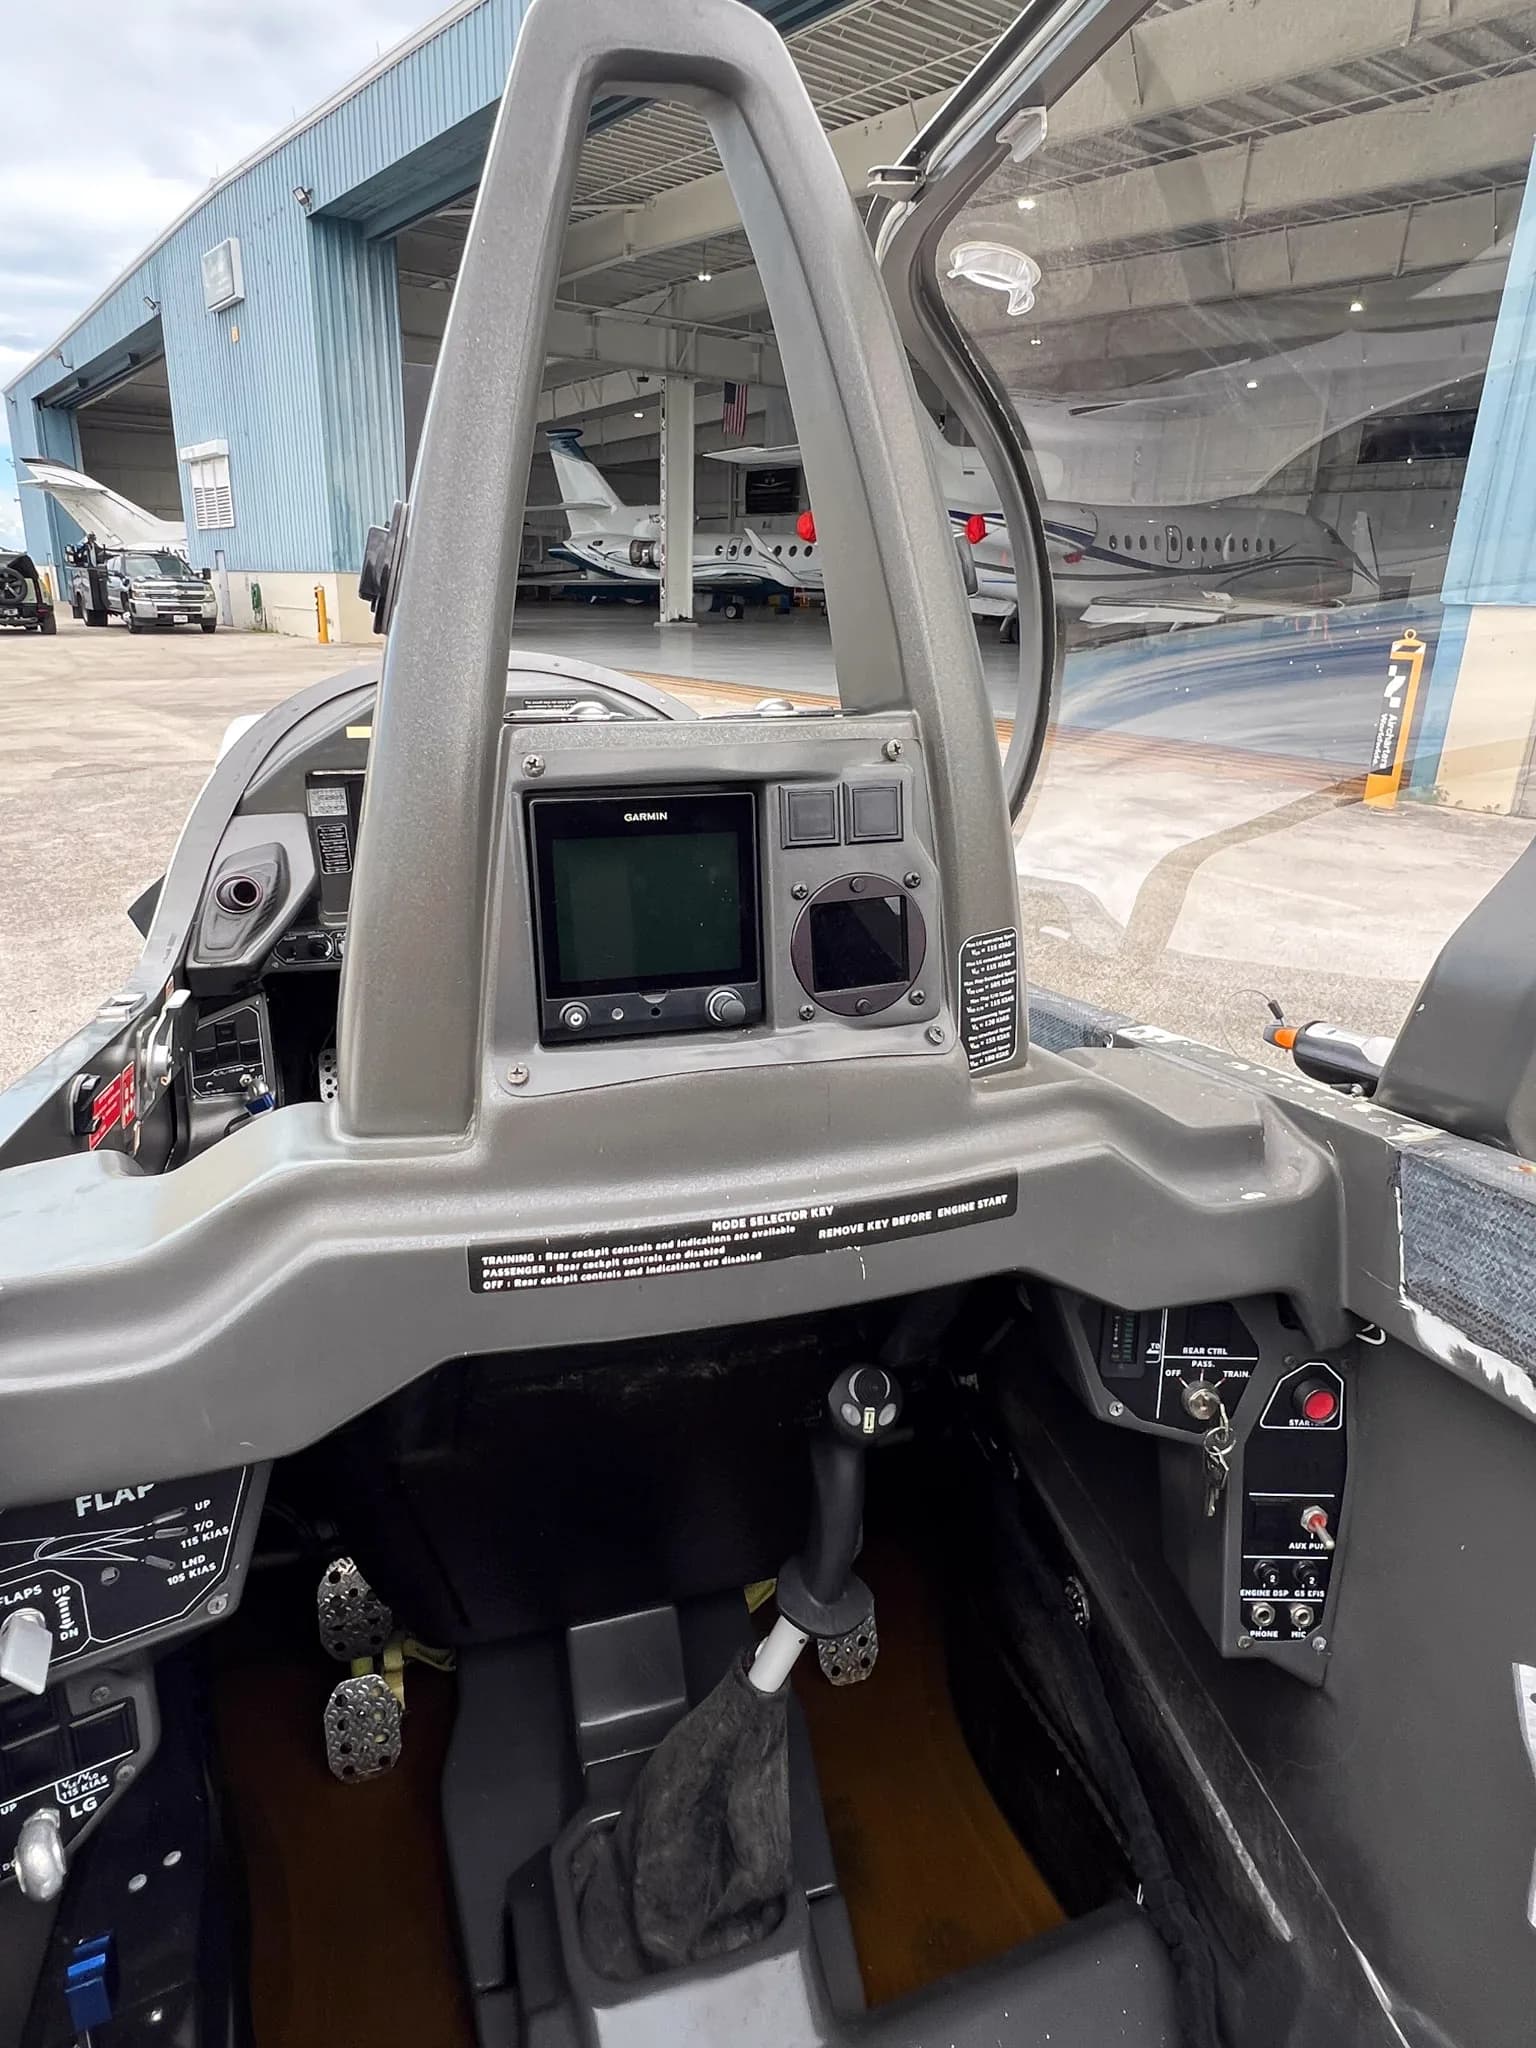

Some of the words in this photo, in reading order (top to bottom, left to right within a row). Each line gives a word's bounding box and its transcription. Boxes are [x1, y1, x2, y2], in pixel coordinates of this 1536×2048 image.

[624, 811, 668, 822] GARMIN
[711, 1217, 747, 1232] MODE
[749, 1209, 808, 1227] SELECTOR
[810, 1205, 834, 1218] KEY
[818, 1223, 865, 1239] REMOVE
[867, 1218, 890, 1231] KEY
[891, 1211, 932, 1227] BEFORE
[937, 1202, 975, 1218] ENGINE
[977, 1194, 1008, 1210] START
[482, 1253, 535, 1266] TRAINING
[545, 1251, 569, 1261] Rear
[571, 1247, 609, 1259] cockpit
[612, 1242, 653, 1255] controls
[655, 1240, 675, 1249] and
[677, 1235, 732, 1248] indications
[733, 1232, 750, 1241] are
[751, 1226, 796, 1239] available
[482, 1265, 546, 1278] PASSENGER
[556, 1263, 580, 1273] Rear
[582, 1258, 620, 1270] cockpit
[622, 1252, 663, 1266] controls
[665, 1252, 681, 1261] are
[684, 1245, 726, 1258] disabled
[482, 1280, 504, 1290] OFF
[514, 1278, 538, 1288] Rear
[540, 1273, 578, 1285] cockpit
[580, 1269, 622, 1282] controls
[624, 1267, 643, 1277] and
[645, 1260, 701, 1275] indications
[703, 1257, 719, 1267] are
[721, 1252, 762, 1265] disabled
[1182, 1347, 1205, 1355] REAR
[1207, 1347, 1228, 1356] CTRL
[1165, 1369, 1182, 1377] OFF
[194, 1499, 211, 1511] UP
[193, 1519, 214, 1532] T/O
[180, 1536, 199, 1549] 115
[202, 1525, 229, 1542] KIAS
[1288, 1542, 1307, 1550] AUX
[181, 1554, 206, 1569] LND
[167, 1573, 185, 1586] 105
[188, 1562, 217, 1578] KIAS
[52, 1585, 71, 1597] UP
[1240, 1589, 1271, 1597] ENGINE
[1272, 1589, 1289, 1597] DSP
[60, 1627, 79, 1642] DN
[1250, 1630, 1278, 1638] PHONE
[61, 1788, 79, 1800] 115
[81, 1775, 108, 1792] KIAS
[0, 1803, 17, 1815] UP
[69, 1797, 98, 1819] LG
